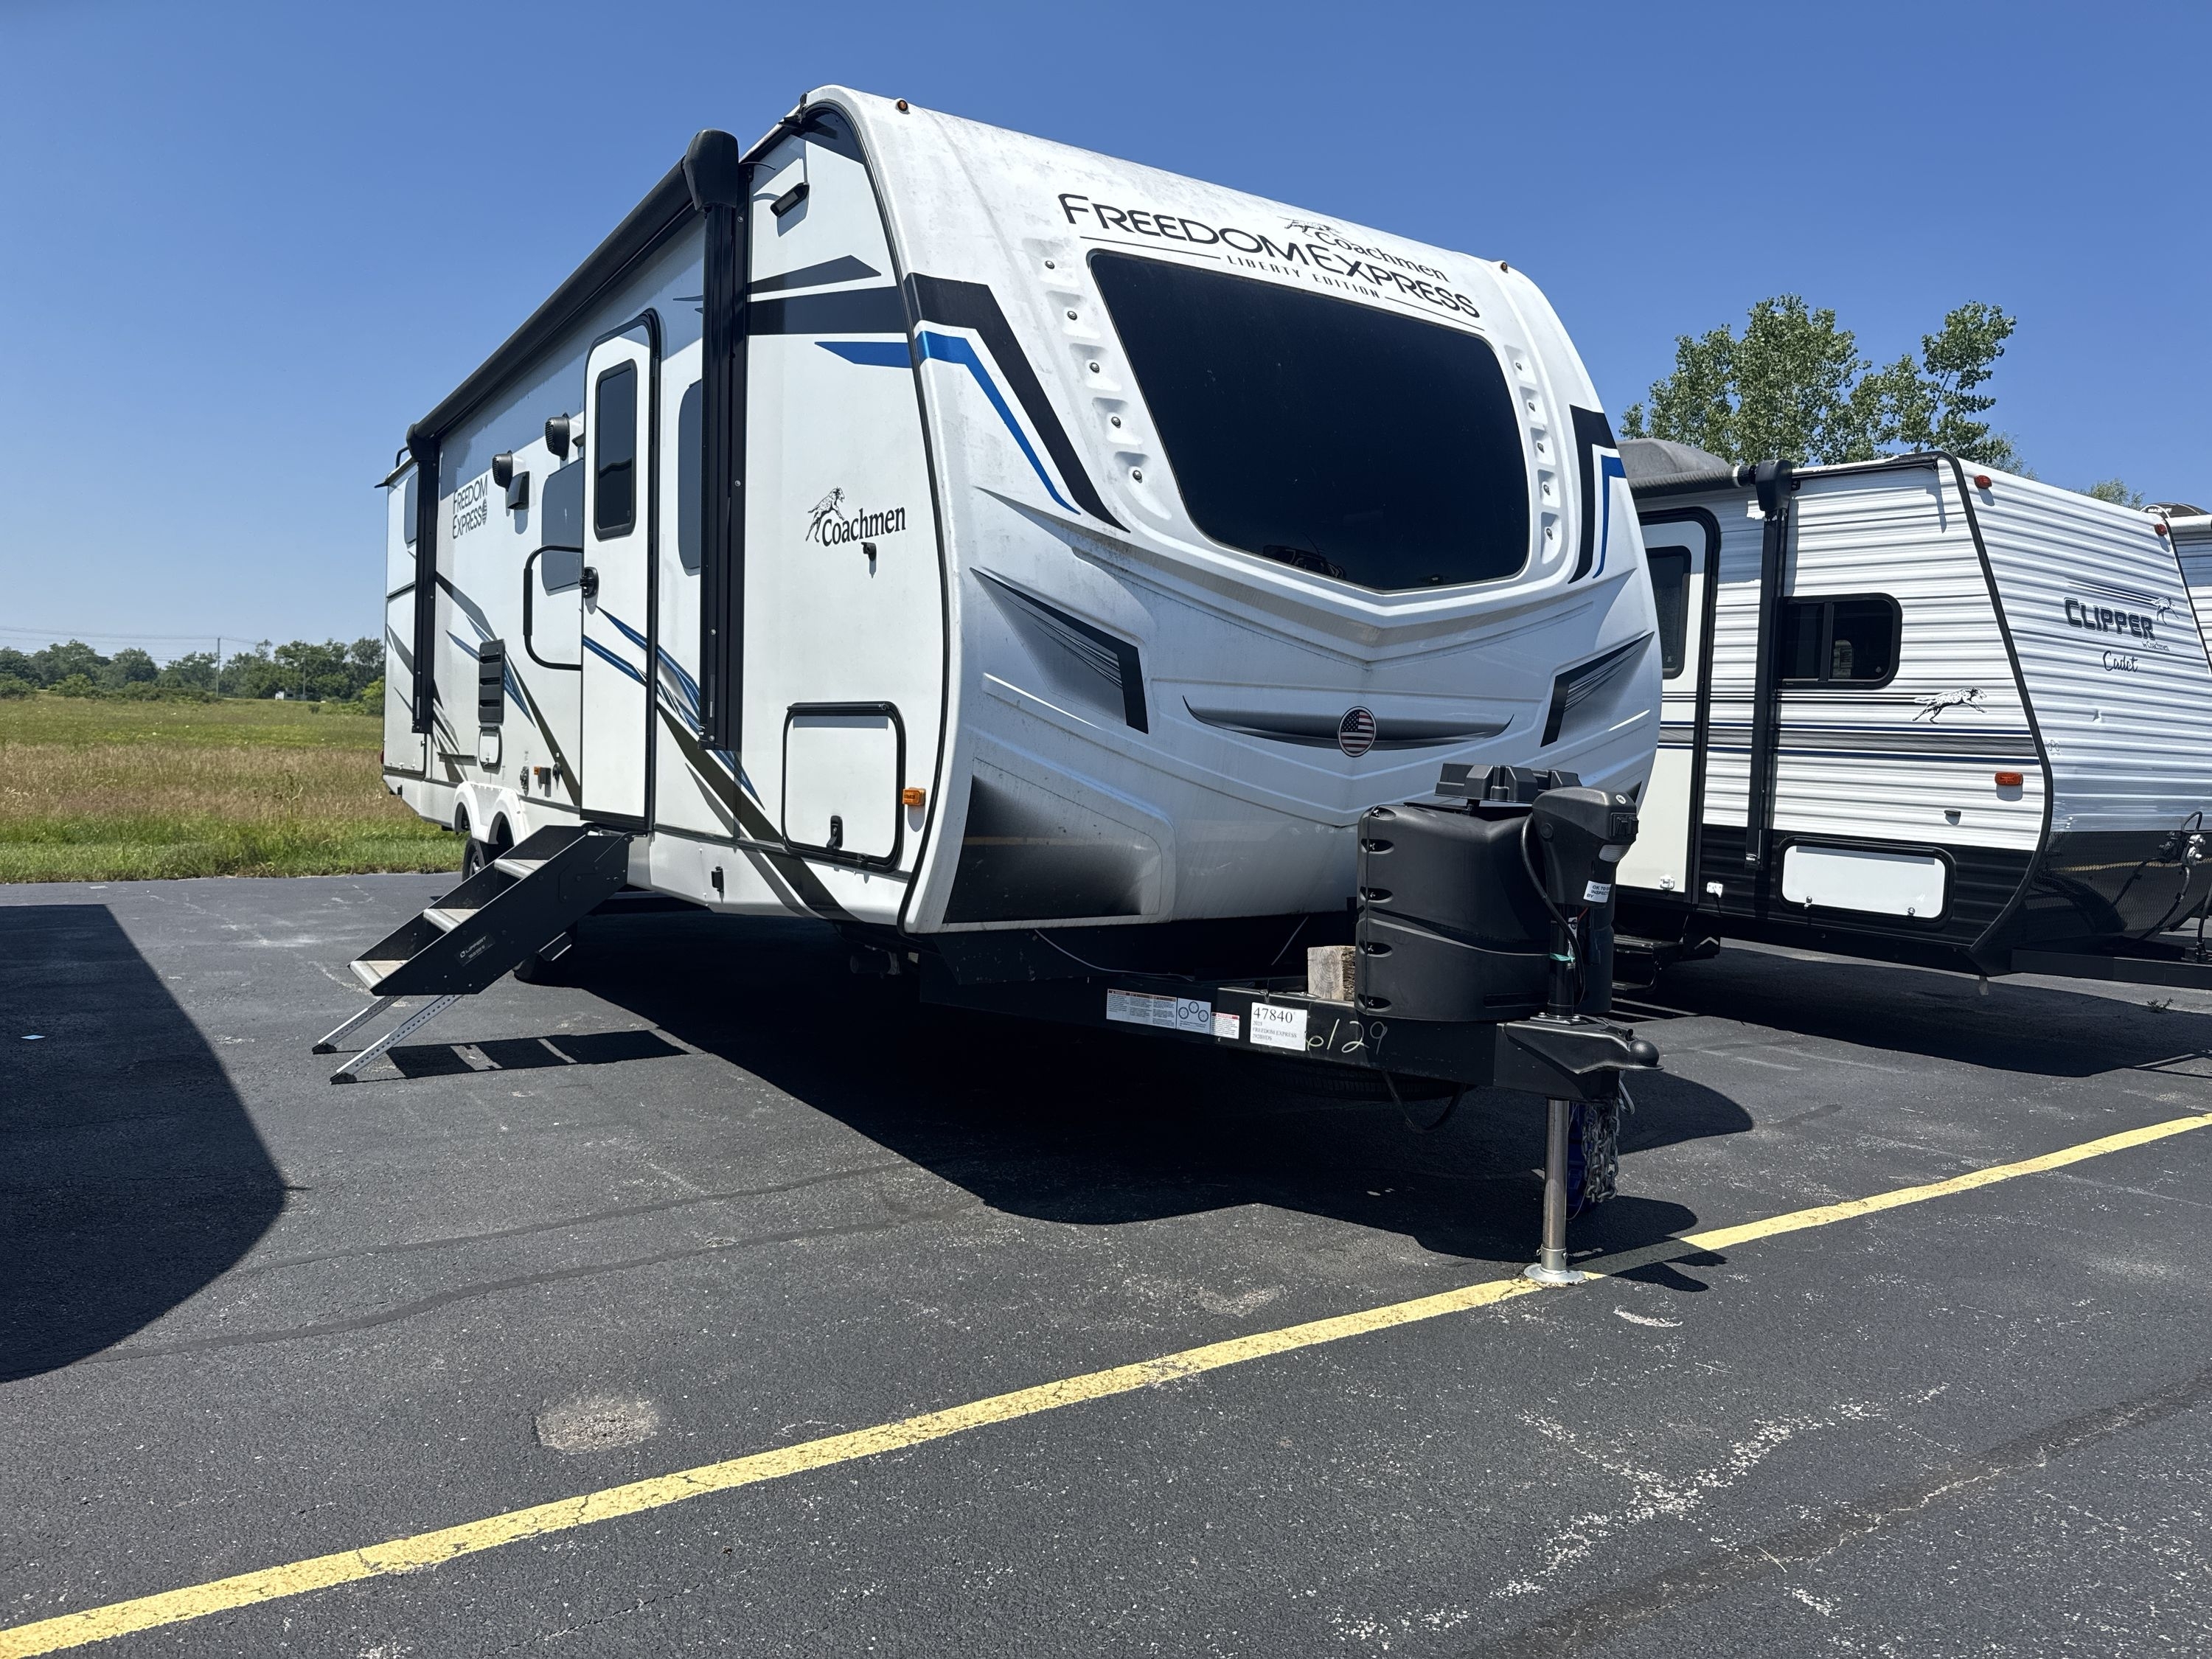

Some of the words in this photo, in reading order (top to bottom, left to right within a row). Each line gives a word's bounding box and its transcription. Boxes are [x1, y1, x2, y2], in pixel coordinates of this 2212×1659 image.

[1227, 255, 1301, 277] LIBERTY
[1312, 274, 1380, 299] EDITION
[1314, 231, 1451, 283] Coachmen
[453, 474, 488, 515] FREEDOM
[452, 505, 482, 540] EXPRESS
[822, 507, 906, 547] Coachmen
[2064, 597, 2156, 641] CLIPPER
[2102, 650, 2139, 673] Cadet
[1252, 1026, 1276, 1035] FREEDOM
[1276, 1030, 1298, 1039] EXPRESS
[1253, 1006, 1293, 1023] 47840
